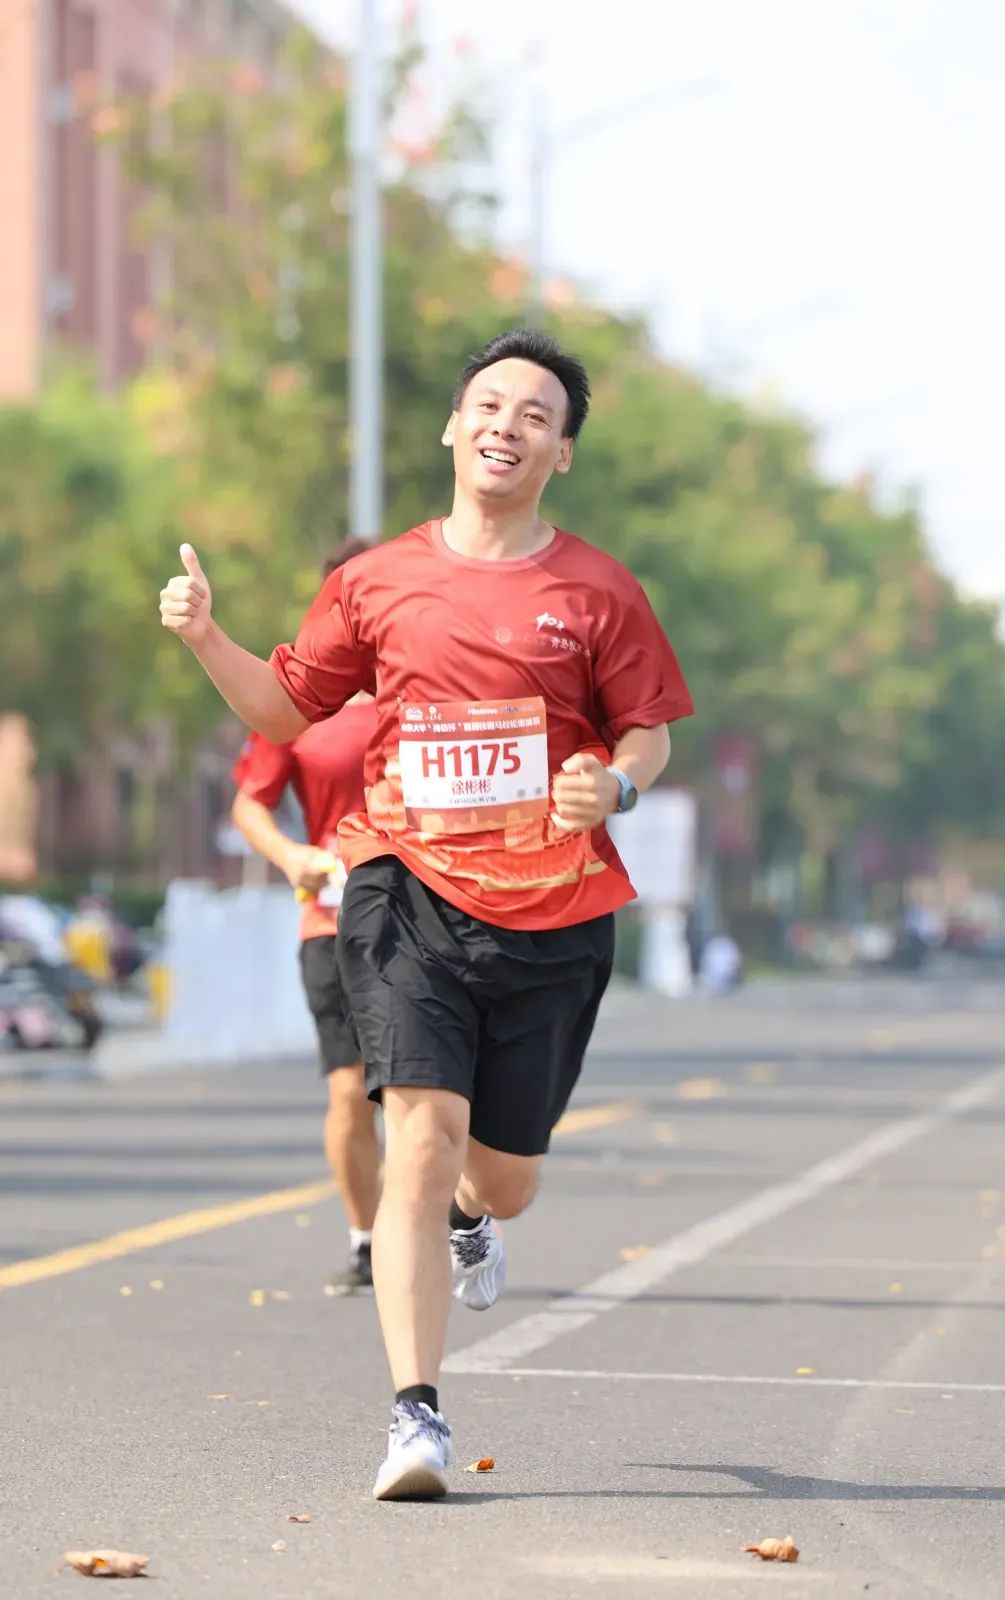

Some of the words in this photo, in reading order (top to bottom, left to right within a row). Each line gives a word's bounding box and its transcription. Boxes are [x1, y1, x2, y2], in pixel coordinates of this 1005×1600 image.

[421, 741, 521, 778] H1175
[452, 778, 492, 795] 徐彬彬
